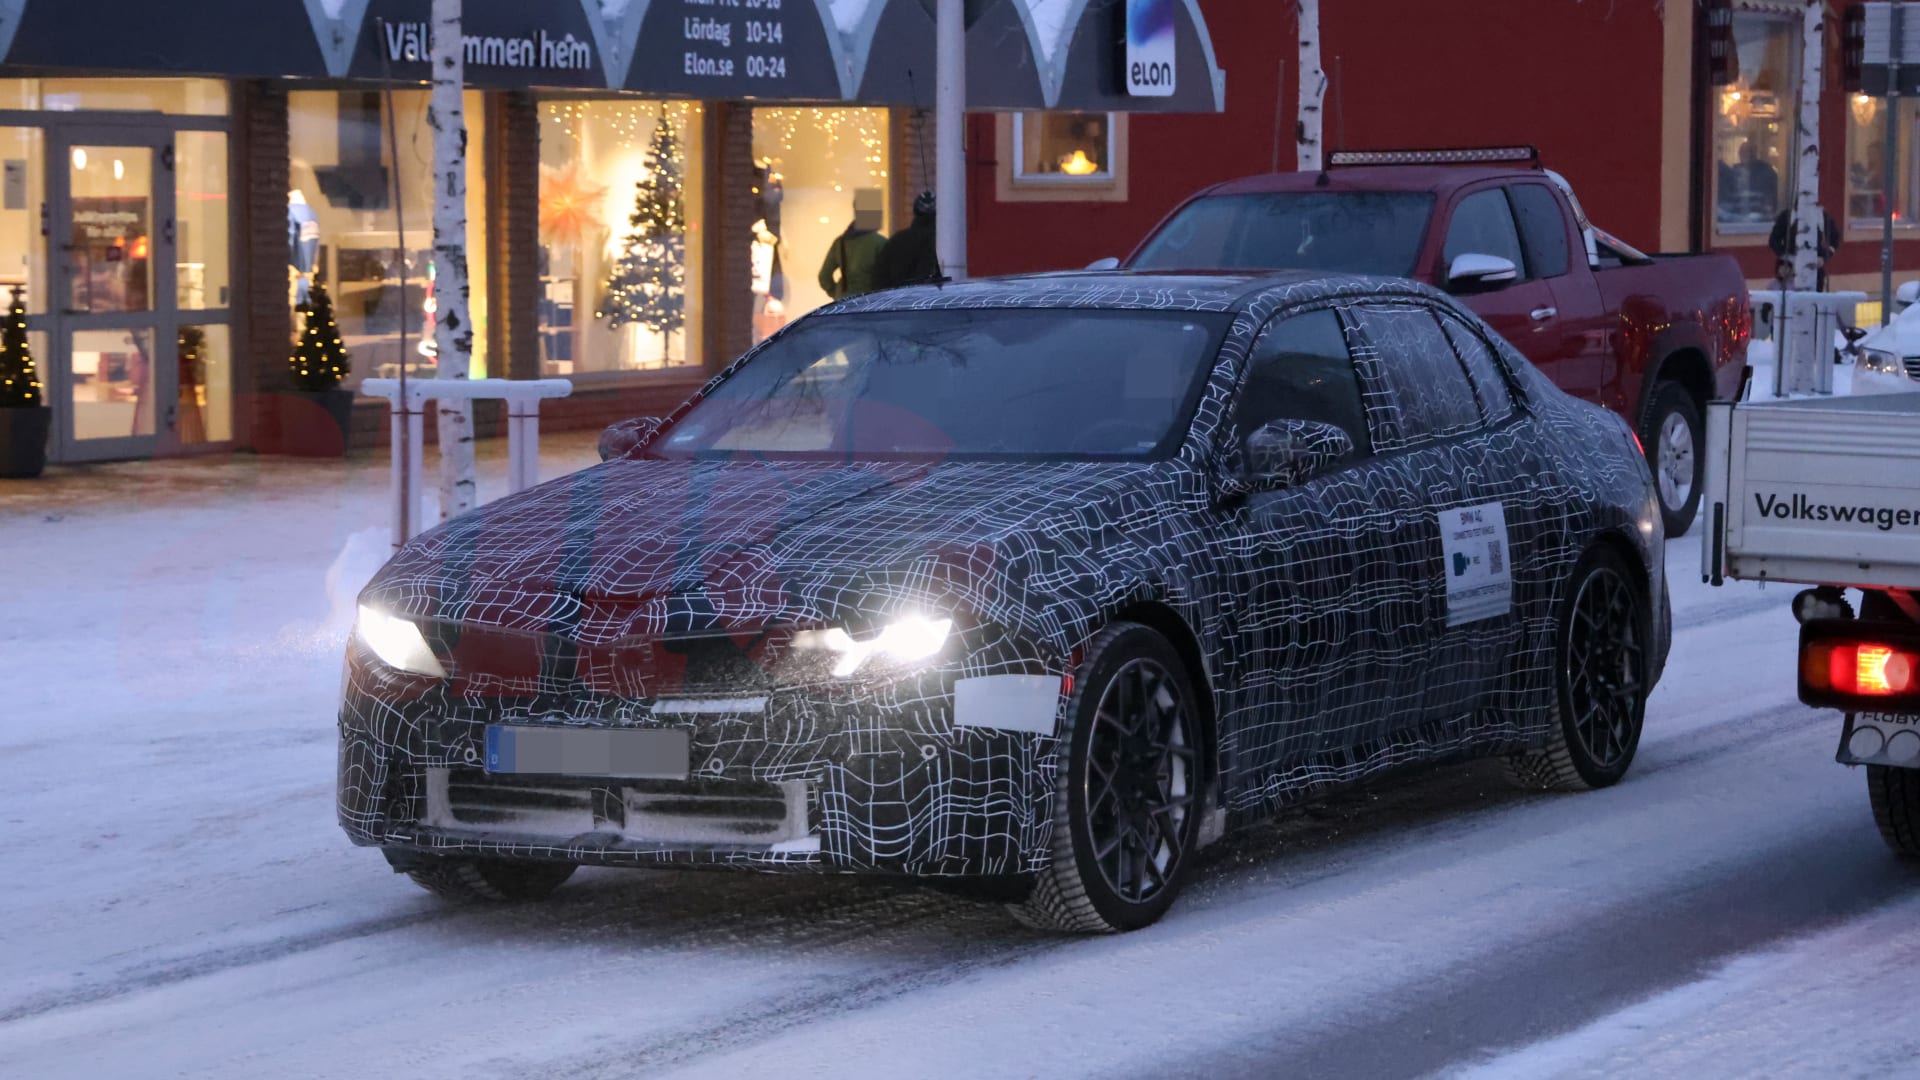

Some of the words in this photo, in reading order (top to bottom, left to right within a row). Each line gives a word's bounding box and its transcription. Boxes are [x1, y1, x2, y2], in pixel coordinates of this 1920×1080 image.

[385, 22, 536, 66] Välmmen
[540, 29, 591, 69] hem
[684, 17, 731, 47] Lördag
[745, 21, 782, 43] 10-14
[684, 52, 734, 76] Elon.se
[746, 56, 786, 78] 00-24
[1131, 62, 1171, 86] elon
